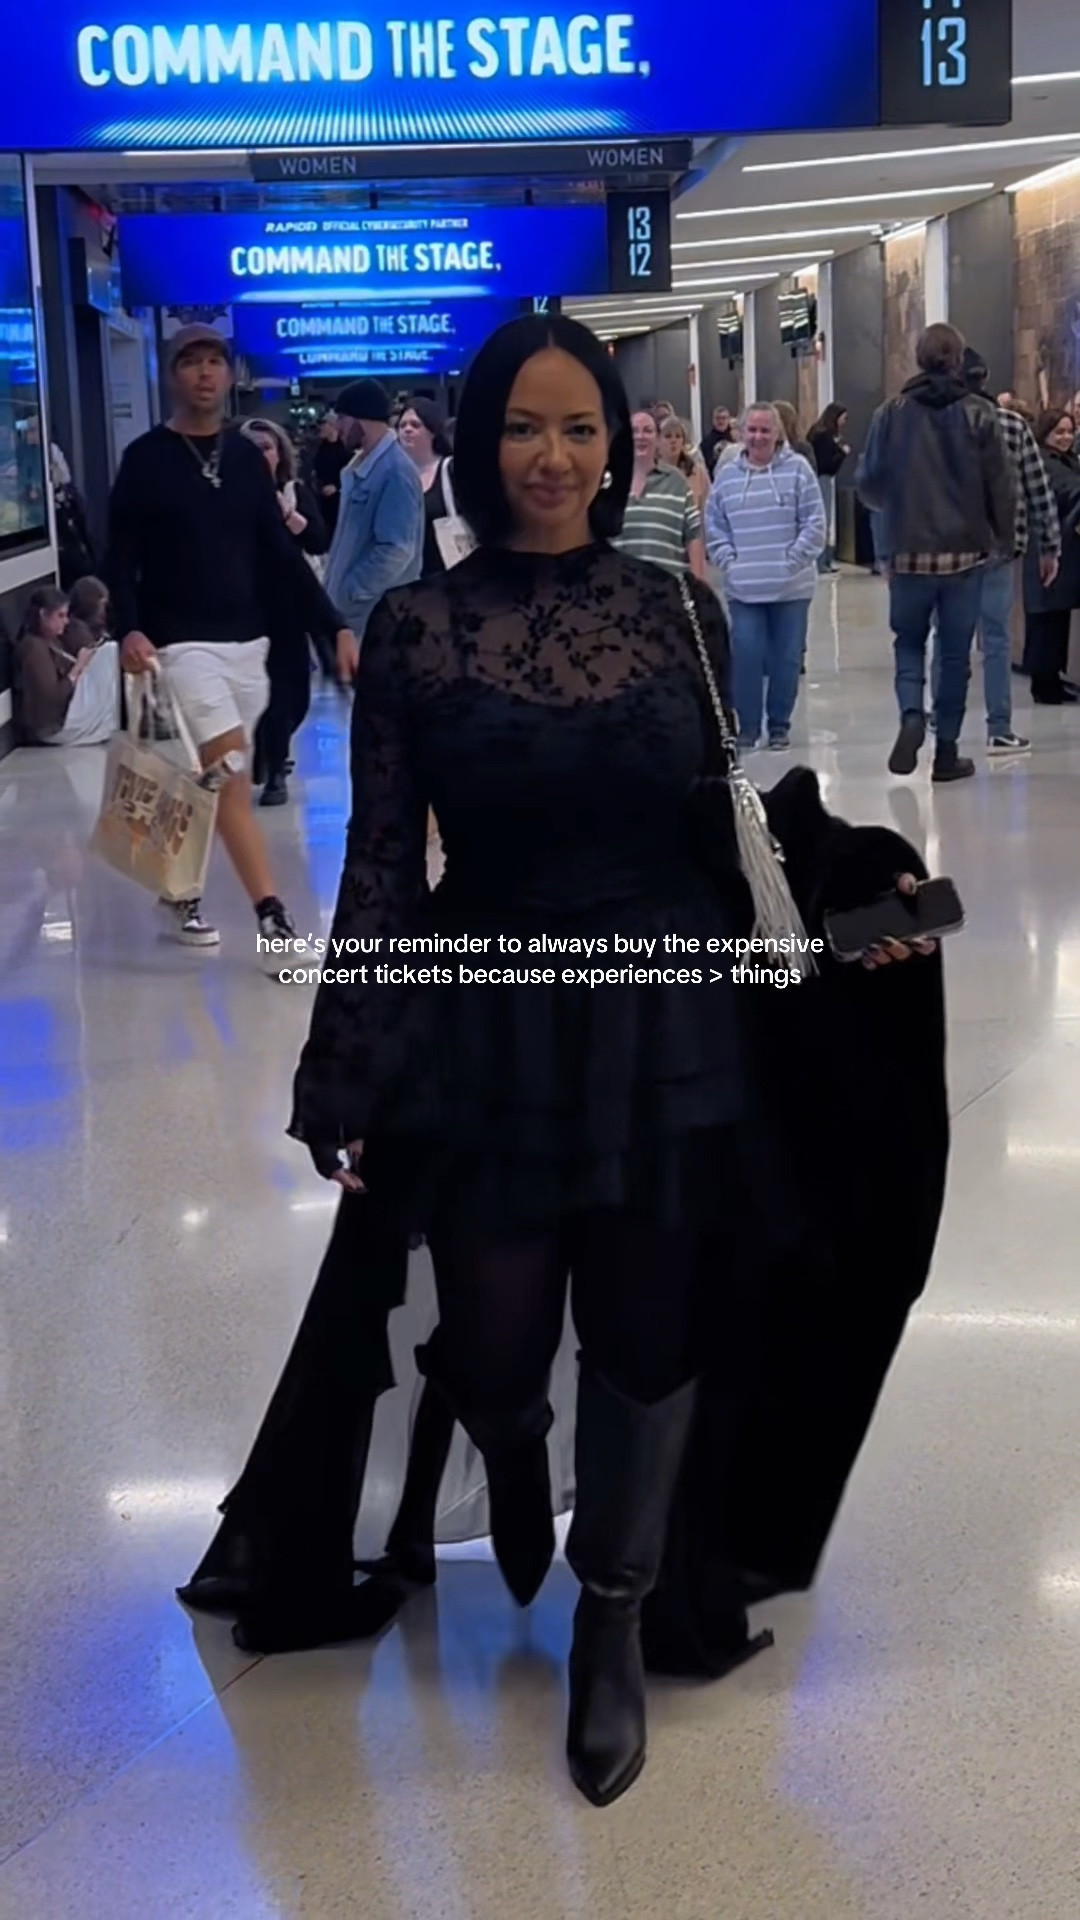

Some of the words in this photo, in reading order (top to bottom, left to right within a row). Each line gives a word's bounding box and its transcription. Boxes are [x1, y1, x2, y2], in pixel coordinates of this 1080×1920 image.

[78, 20, 373, 86] COMMAND
[387, 20, 456, 79] THE
[468, 14, 651, 77] STAGE,
[920, 17, 966, 86] 13
[279, 156, 357, 175] WOMEN
[587, 147, 664, 167] WOMEN
[628, 206, 651, 241] 13
[230, 244, 371, 276] COMMAND
[375, 243, 409, 273] THE
[413, 240, 502, 272] STAGE,
[629, 243, 652, 276] 12
[276, 315, 370, 338] COMMAND
[373, 315, 395, 335] THE
